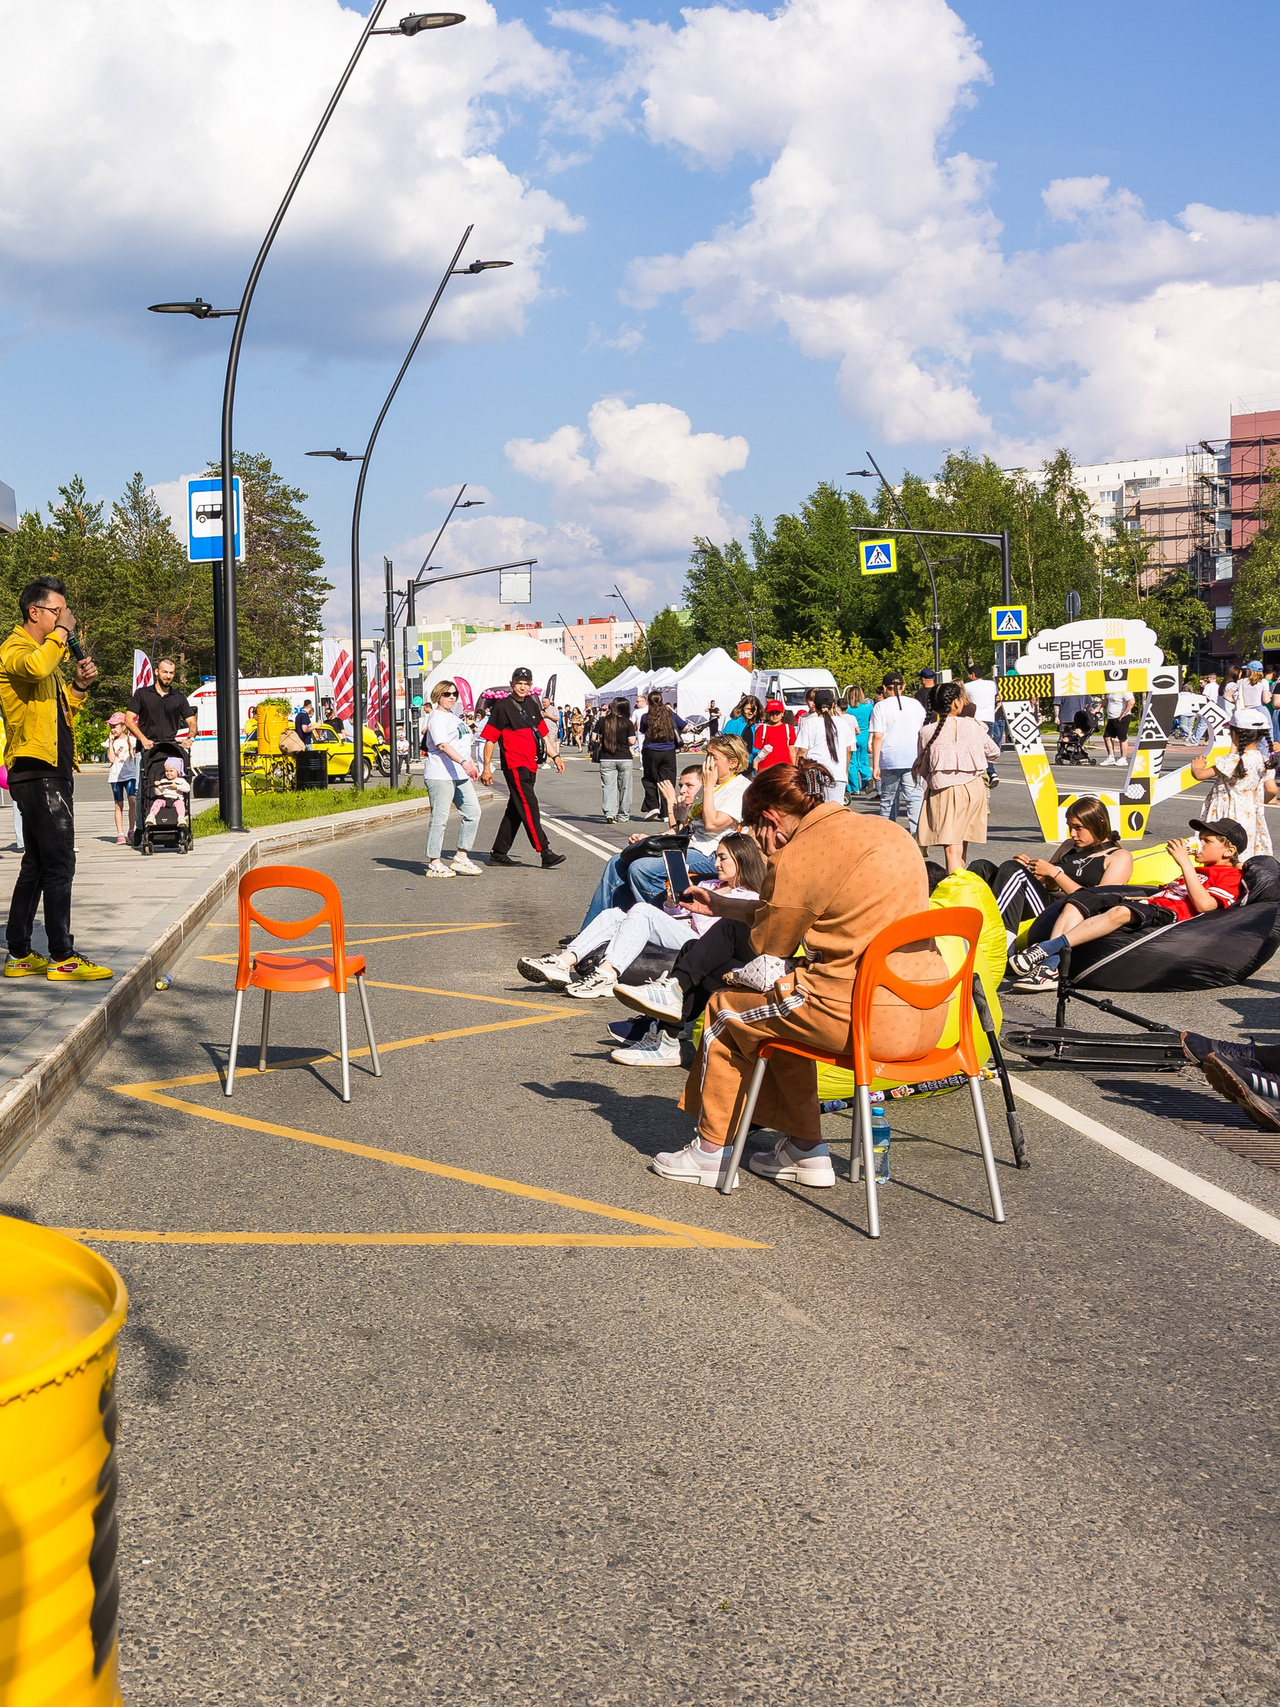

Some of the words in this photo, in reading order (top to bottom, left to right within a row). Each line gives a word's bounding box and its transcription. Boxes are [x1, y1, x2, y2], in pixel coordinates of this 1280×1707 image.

[1038, 639, 1104, 652] ЧЕРНОЕ
[1038, 662, 1076, 670] КОФЕЙНЫЙ
[1076, 659, 1116, 668] ФЕСТИВАЛЬ
[1128, 657, 1151, 665] ЯМАЛЕ
